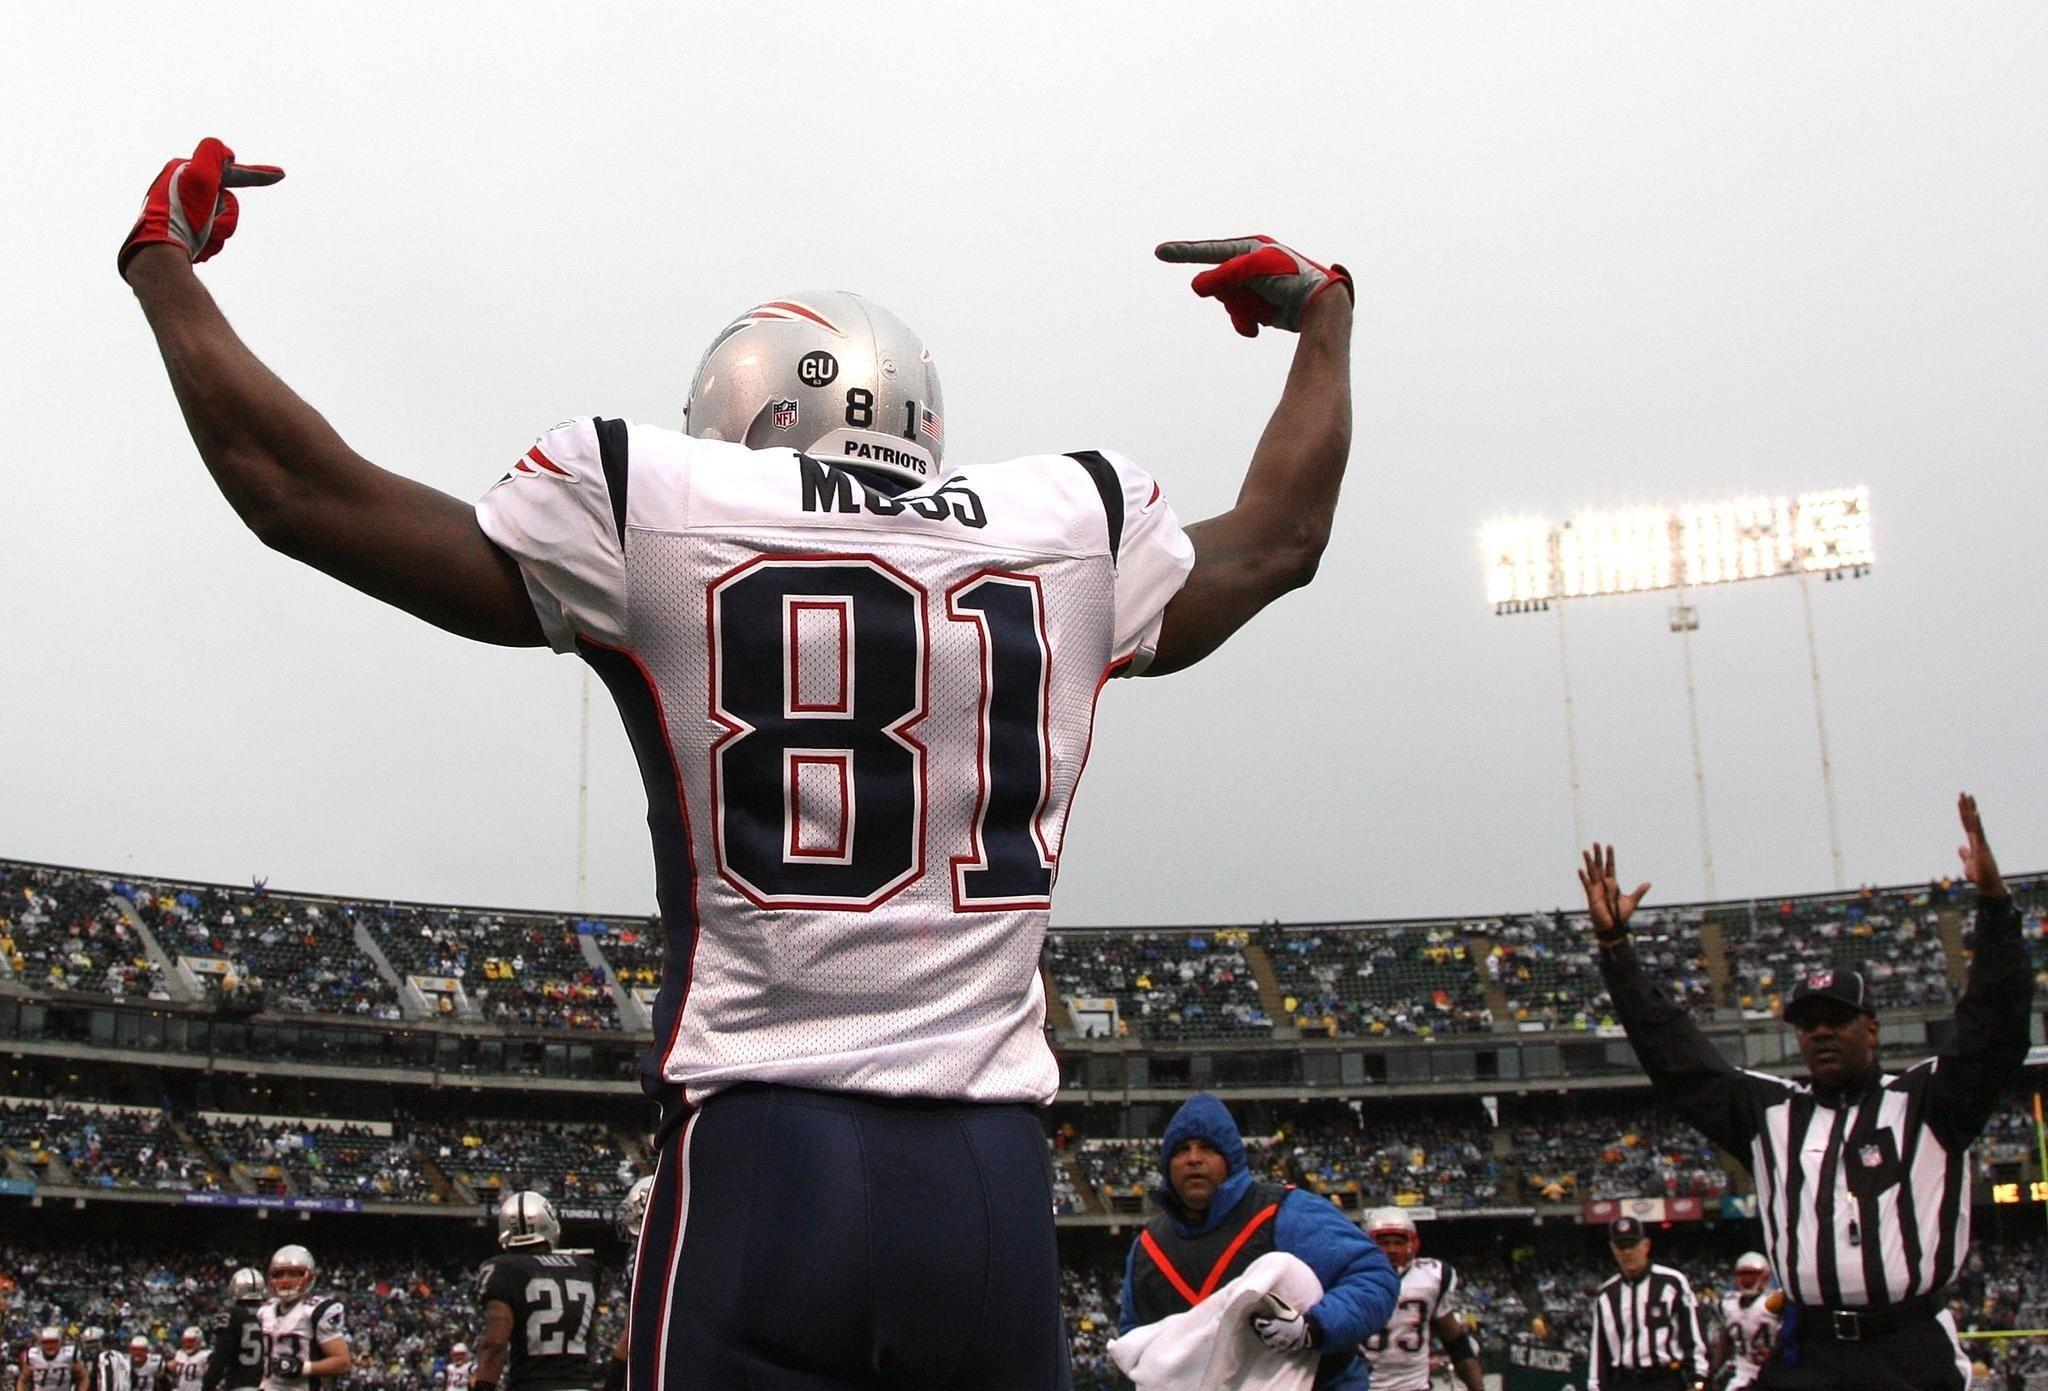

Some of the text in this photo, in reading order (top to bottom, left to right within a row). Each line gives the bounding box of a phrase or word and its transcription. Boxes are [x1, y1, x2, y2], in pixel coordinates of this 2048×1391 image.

[802, 358, 833, 379] GU
[776, 410, 796, 427] NFL
[844, 441, 927, 475] PATRIOTS
[706, 552, 1056, 913] 81
[560, 1208, 600, 1219] TUNDRA
[525, 1278, 595, 1355] 27
